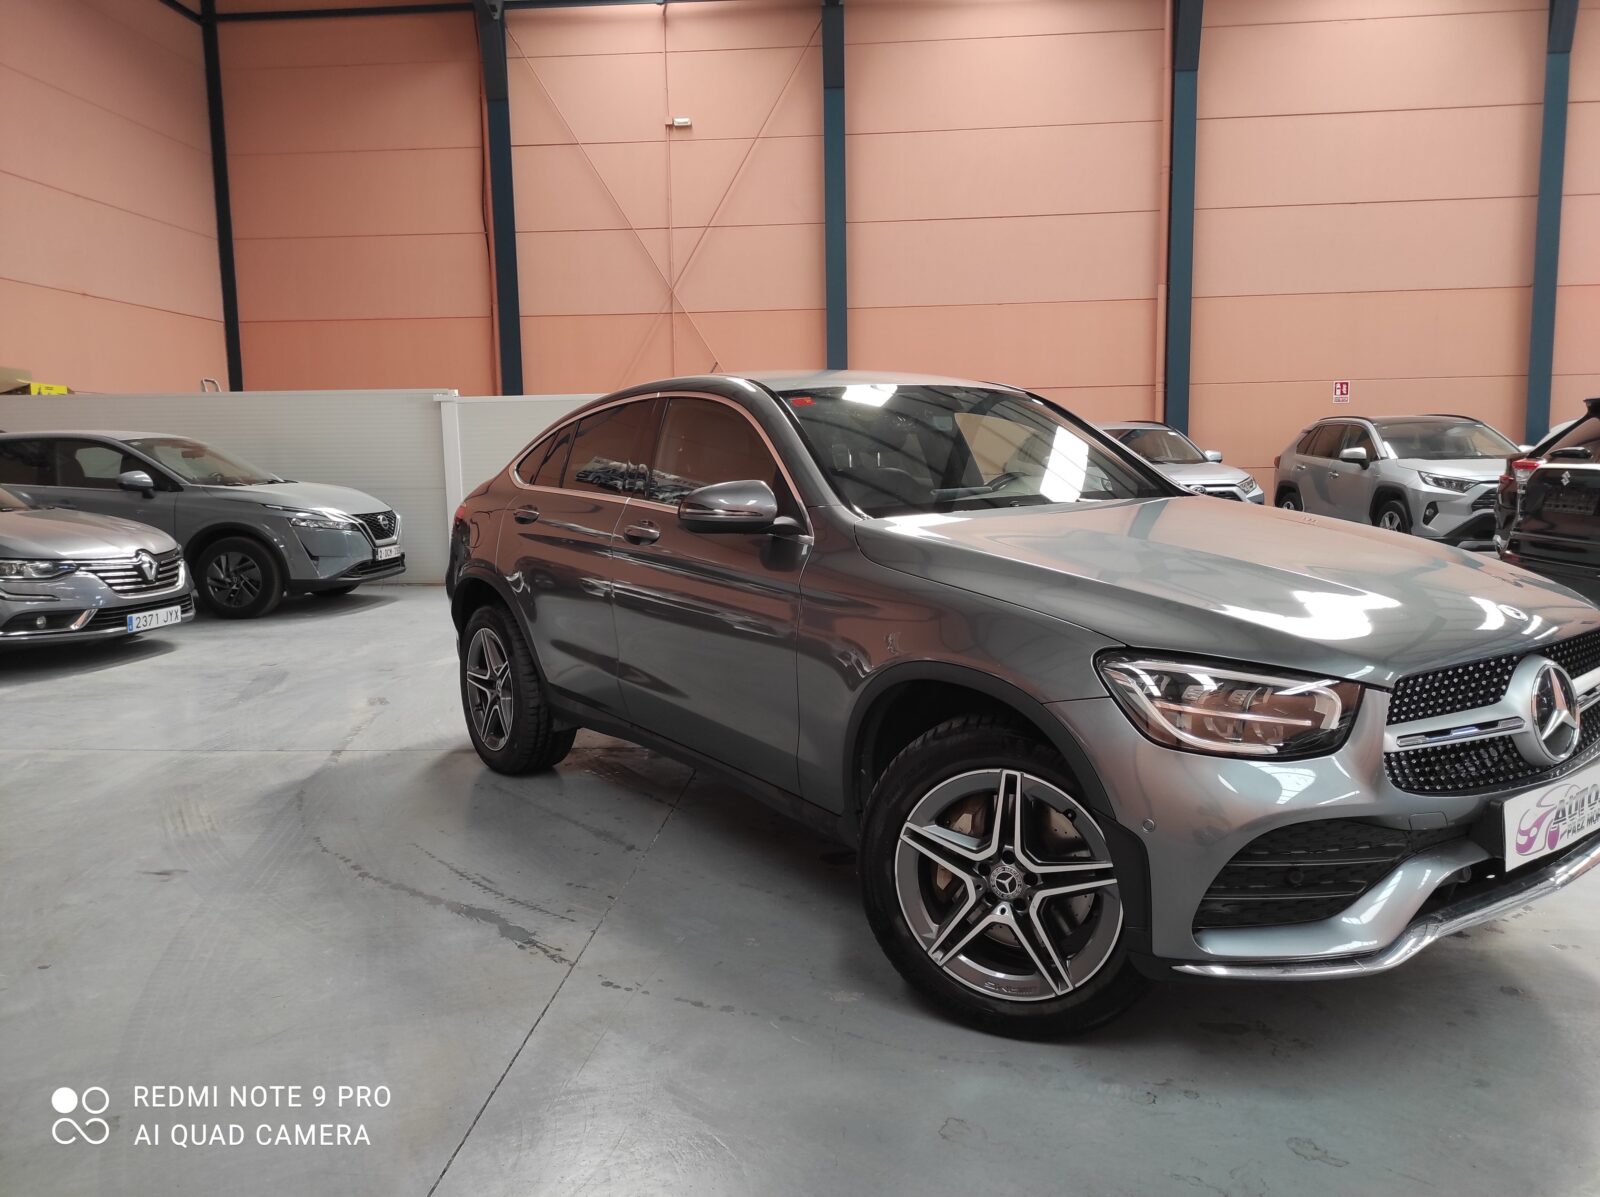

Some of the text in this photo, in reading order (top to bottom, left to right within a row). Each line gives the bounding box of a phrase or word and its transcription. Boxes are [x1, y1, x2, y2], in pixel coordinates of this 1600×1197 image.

[135, 608, 179, 629] 2371 JYX
[1553, 783, 1600, 825] AUTO
